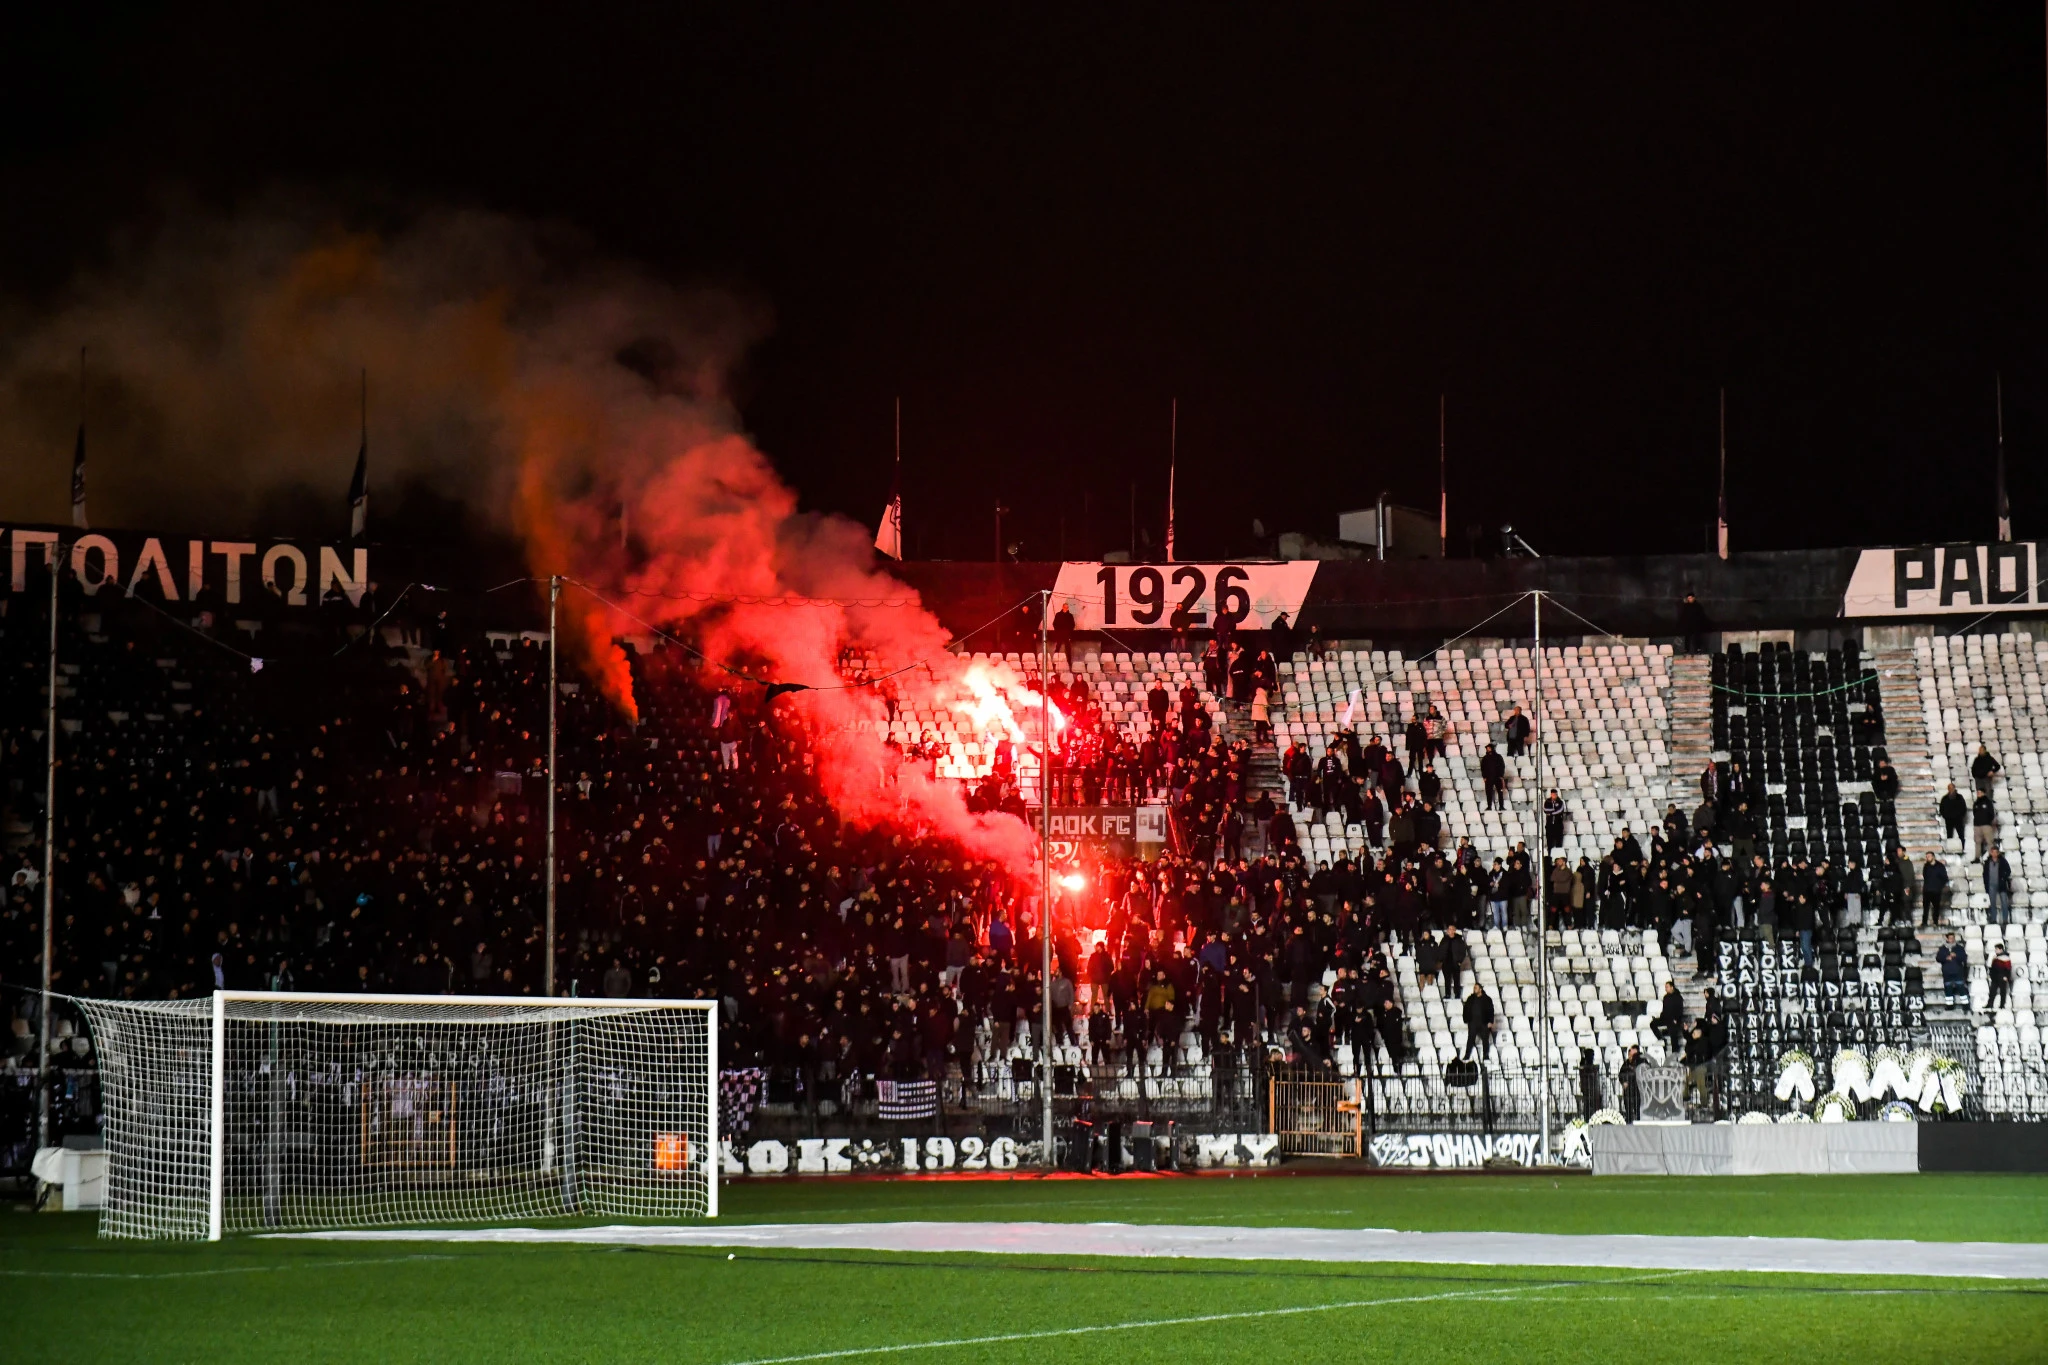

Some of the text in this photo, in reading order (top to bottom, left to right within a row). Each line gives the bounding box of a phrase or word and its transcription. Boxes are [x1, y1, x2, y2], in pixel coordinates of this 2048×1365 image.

[0, 527, 368, 608] ΠΟΛΙΤΩΝ
[1895, 542, 2048, 608] PAO
[1097, 566, 1250, 625] 1926
[1102, 815, 1131, 835] FC
[1719, 969, 1799, 985] EAST
[1722, 980, 1903, 999] OFFENDERS
[900, 1136, 1019, 1171] 1926
